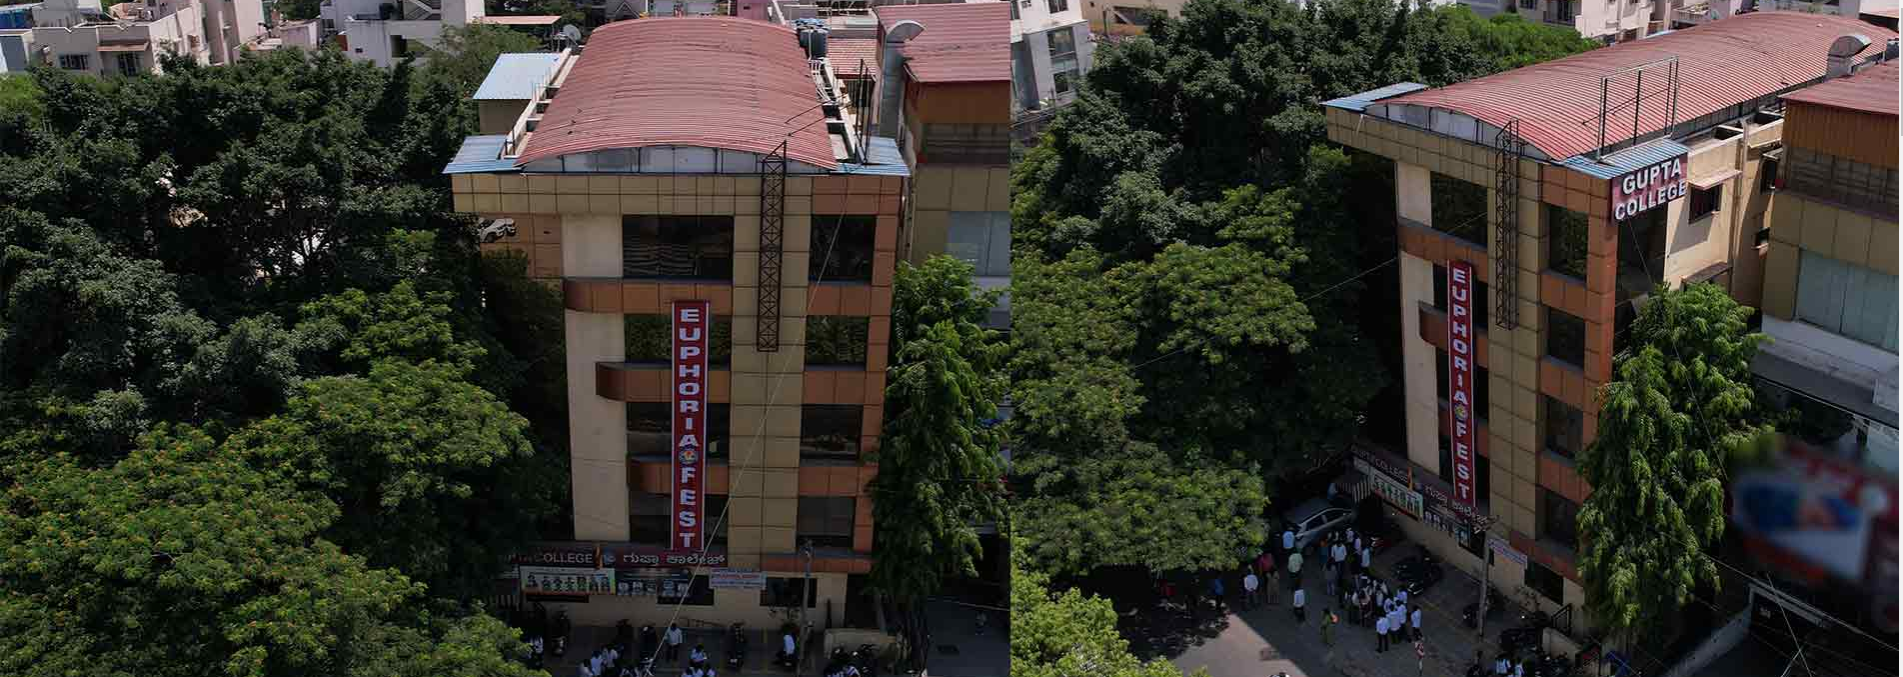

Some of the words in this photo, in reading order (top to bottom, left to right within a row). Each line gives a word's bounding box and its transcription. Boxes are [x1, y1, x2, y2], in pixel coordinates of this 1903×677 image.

[1615, 179, 1686, 220] COLLEGE
[1623, 158, 1681, 194] GUPTA
[1452, 267, 1468, 405] EUPHORIA
[679, 308, 700, 448] EUPHORIA
[1456, 422, 1470, 499] FEST
[679, 467, 697, 548] FEST
